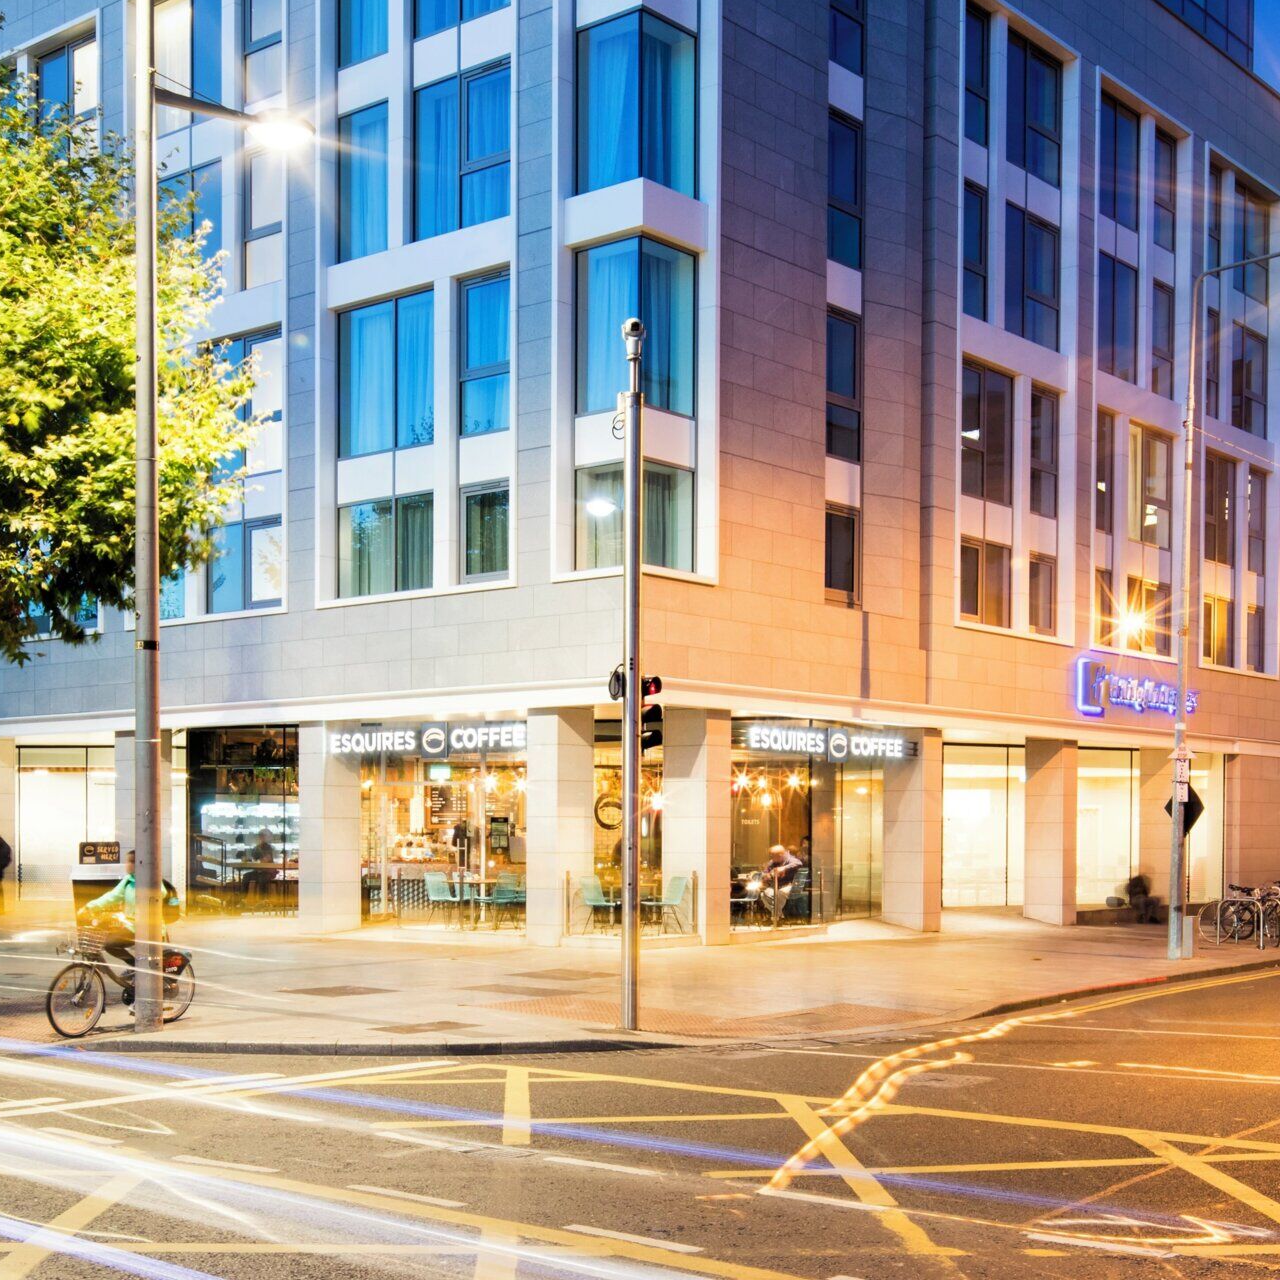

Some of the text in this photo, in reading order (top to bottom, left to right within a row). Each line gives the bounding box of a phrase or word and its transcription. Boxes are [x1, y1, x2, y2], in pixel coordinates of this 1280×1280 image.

[329, 724, 526, 753] ESQUIRES COFFEE
[750, 728, 903, 757] ESQUIRES COFFEE
